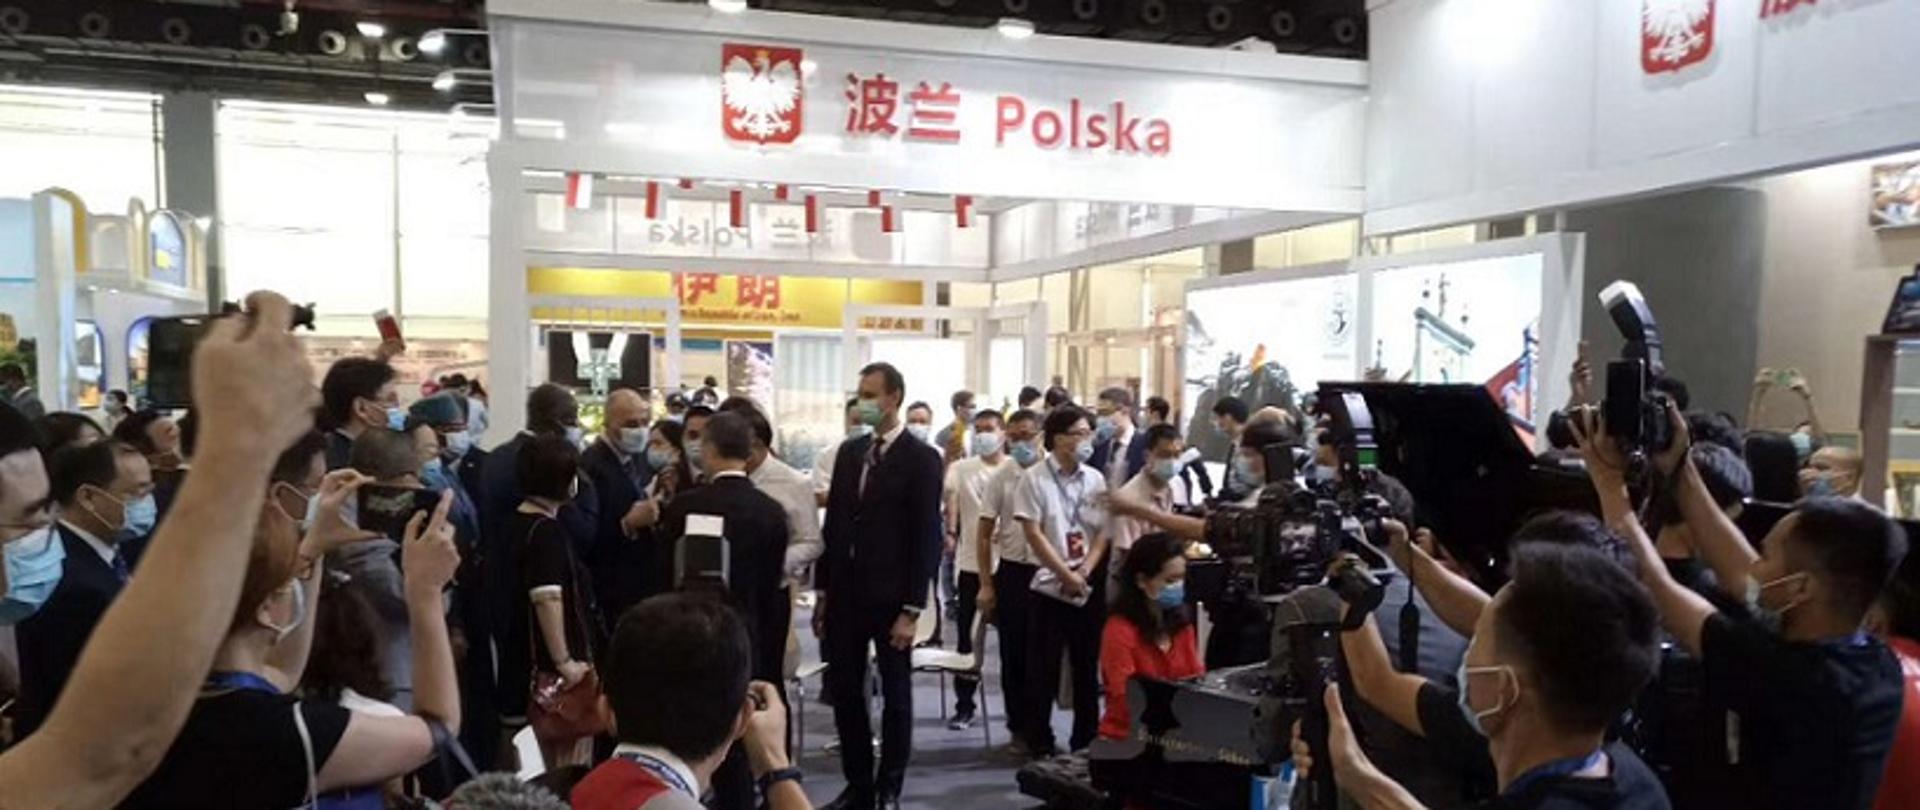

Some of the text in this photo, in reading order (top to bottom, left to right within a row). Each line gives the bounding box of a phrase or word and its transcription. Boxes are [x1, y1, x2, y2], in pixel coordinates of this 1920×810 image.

[845, 72, 1172, 155] 波兰 Polska
[671, 272, 780, 309] 伊朗
